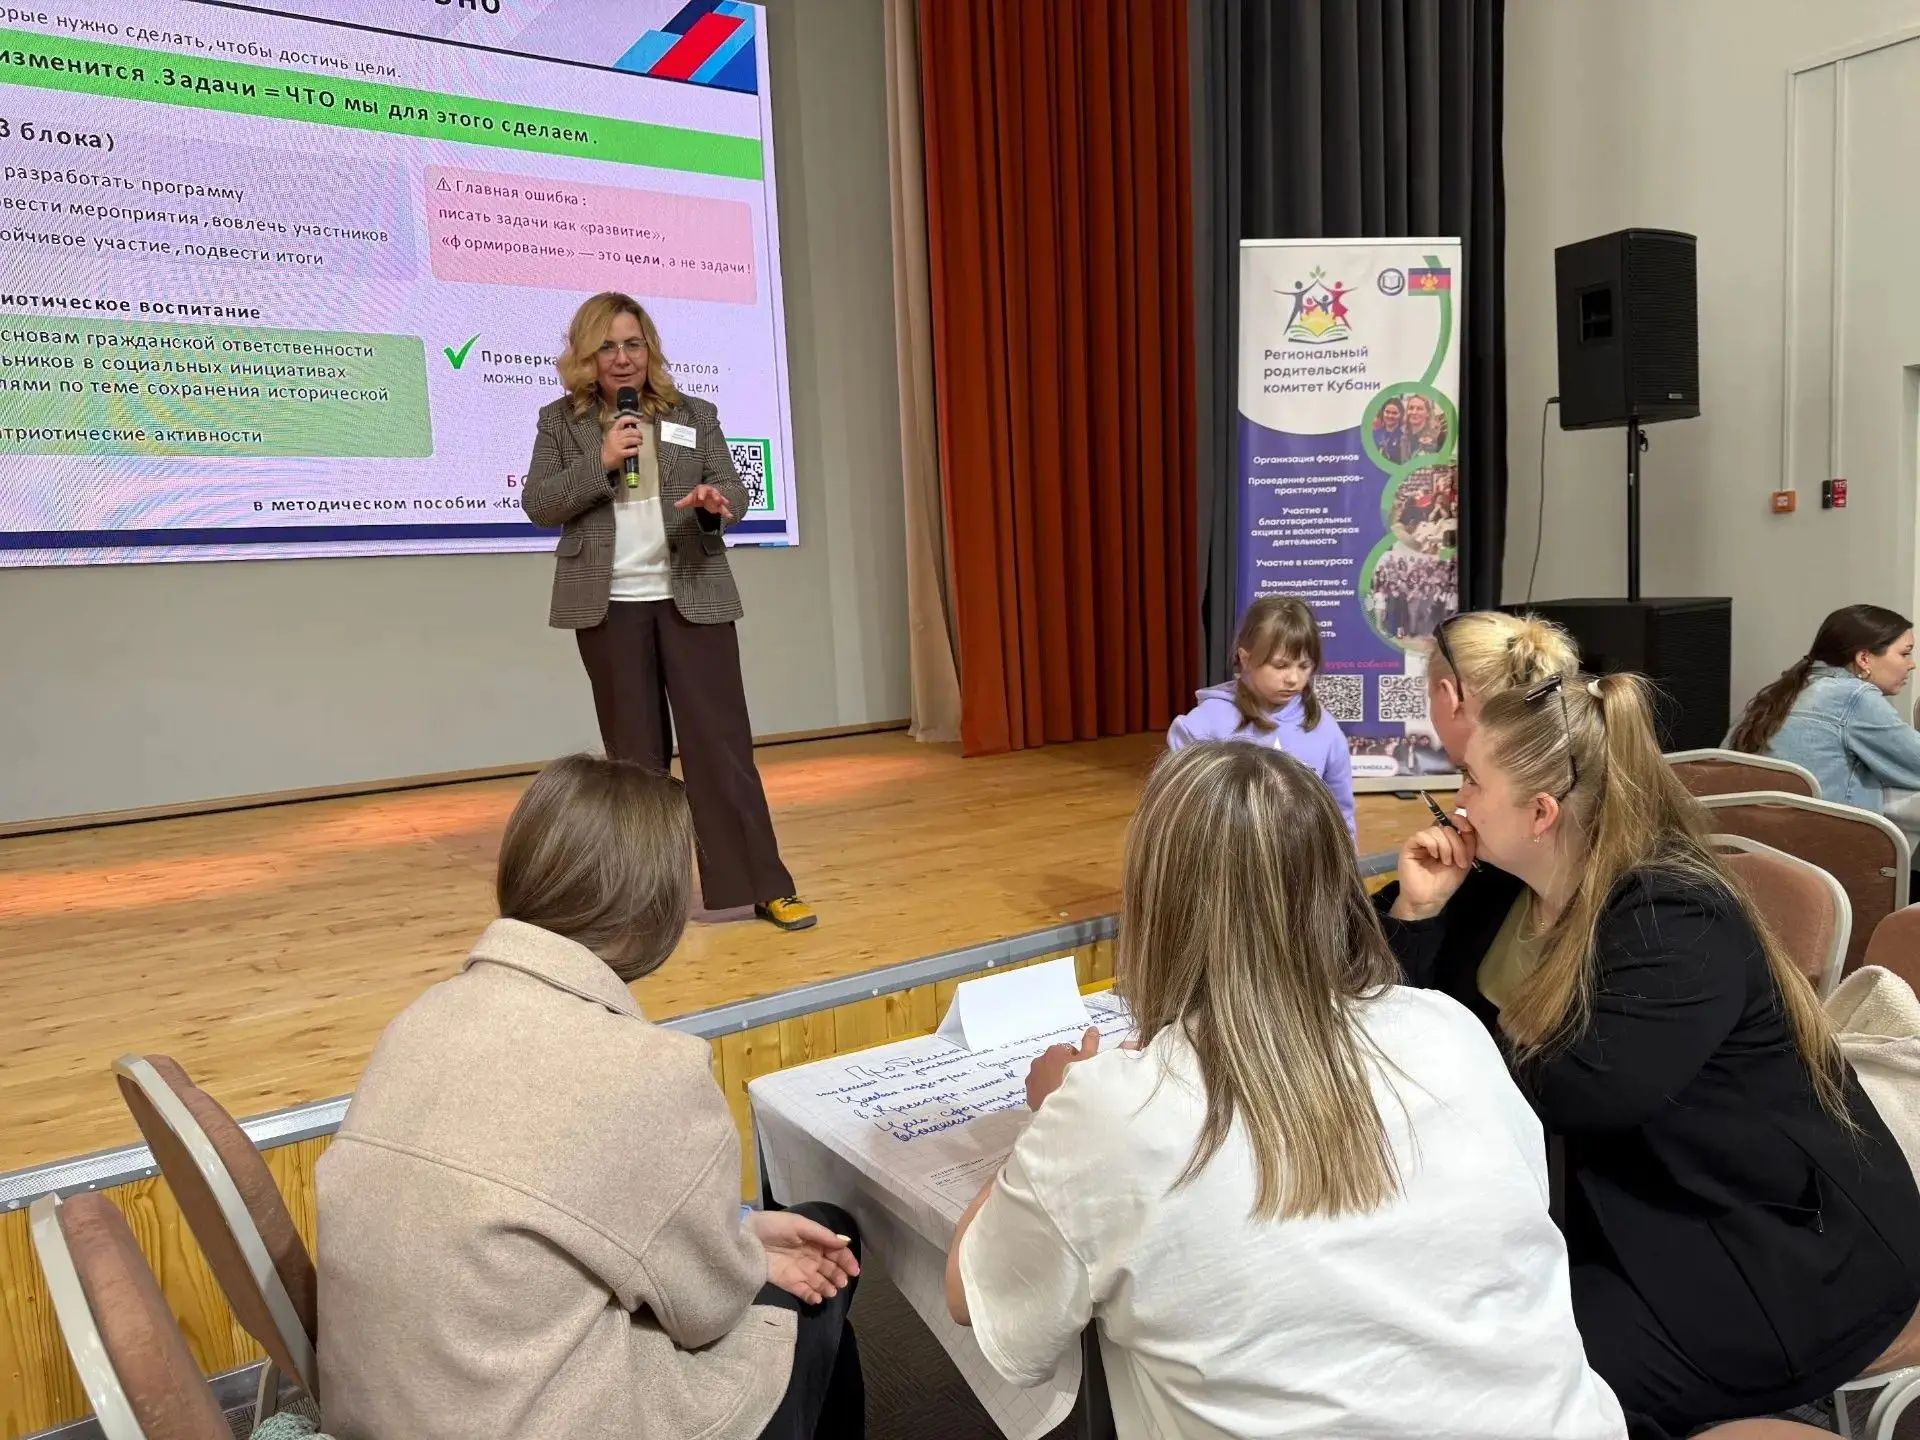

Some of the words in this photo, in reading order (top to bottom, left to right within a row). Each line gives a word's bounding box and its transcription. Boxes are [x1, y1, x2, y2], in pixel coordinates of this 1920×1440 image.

[57, 15, 118, 35] нужно
[279, 47, 348, 70] достичь
[355, 61, 401, 78] цели.
[345, 98, 378, 115] мы
[389, 103, 428, 121] для
[437, 111, 493, 130] этого
[501, 118, 598, 145] сделаем.
[20, 121, 115, 153] блока)
[4, 165, 135, 190] разработать
[142, 180, 244, 202] программу
[456, 180, 519, 199] Главная
[293, 222, 388, 243] участников
[439, 209, 491, 223] писать
[496, 213, 548, 231] задачи
[553, 219, 577, 232] как
[580, 222, 666, 243] «развитие»,
[0, 227, 86, 247] ойчивое
[276, 250, 323, 266] итоги
[598, 250, 621, 264] это
[625, 253, 665, 269] цели,
[669, 258, 676, 268] а
[681, 259, 696, 270] не
[140, 300, 261, 319] воспитание
[87, 333, 215, 351] гражданской
[223, 338, 374, 358] ответственности
[1264, 347, 1369, 361] Региональный
[84, 358, 94, 369] в
[102, 357, 222, 375] социальных
[230, 364, 346, 379] инициативах
[1263, 364, 1367, 379] родительский
[483, 373, 533, 385] можно
[1263, 383, 1323, 394] комитет
[1327, 379, 1381, 393] Кубани
[60, 381, 83, 393] по
[90, 381, 139, 394] теме
[147, 382, 259, 399] сохранения
[268, 386, 389, 402] исторической
[688, 383, 719, 394] цели
[0, 428, 145, 442] триотические
[154, 428, 263, 443] активности
[1253, 454, 1315, 465] Организация
[1316, 453, 1360, 464] форумов
[1248, 476, 1305, 486] Проведение
[1274, 485, 1337, 495] практикумов
[254, 500, 263, 511] в
[271, 498, 407, 514] методическом
[413, 495, 486, 509] пособии
[1281, 507, 1320, 515] Участие
[1258, 515, 1352, 526] благотворительных
[1251, 528, 1283, 537] акциях
[1272, 538, 1337, 547] деятельность
[1256, 558, 1295, 567] Участие
[1304, 558, 1354, 568] конкурсах
[1261, 578, 1340, 588] Взаимодействие
